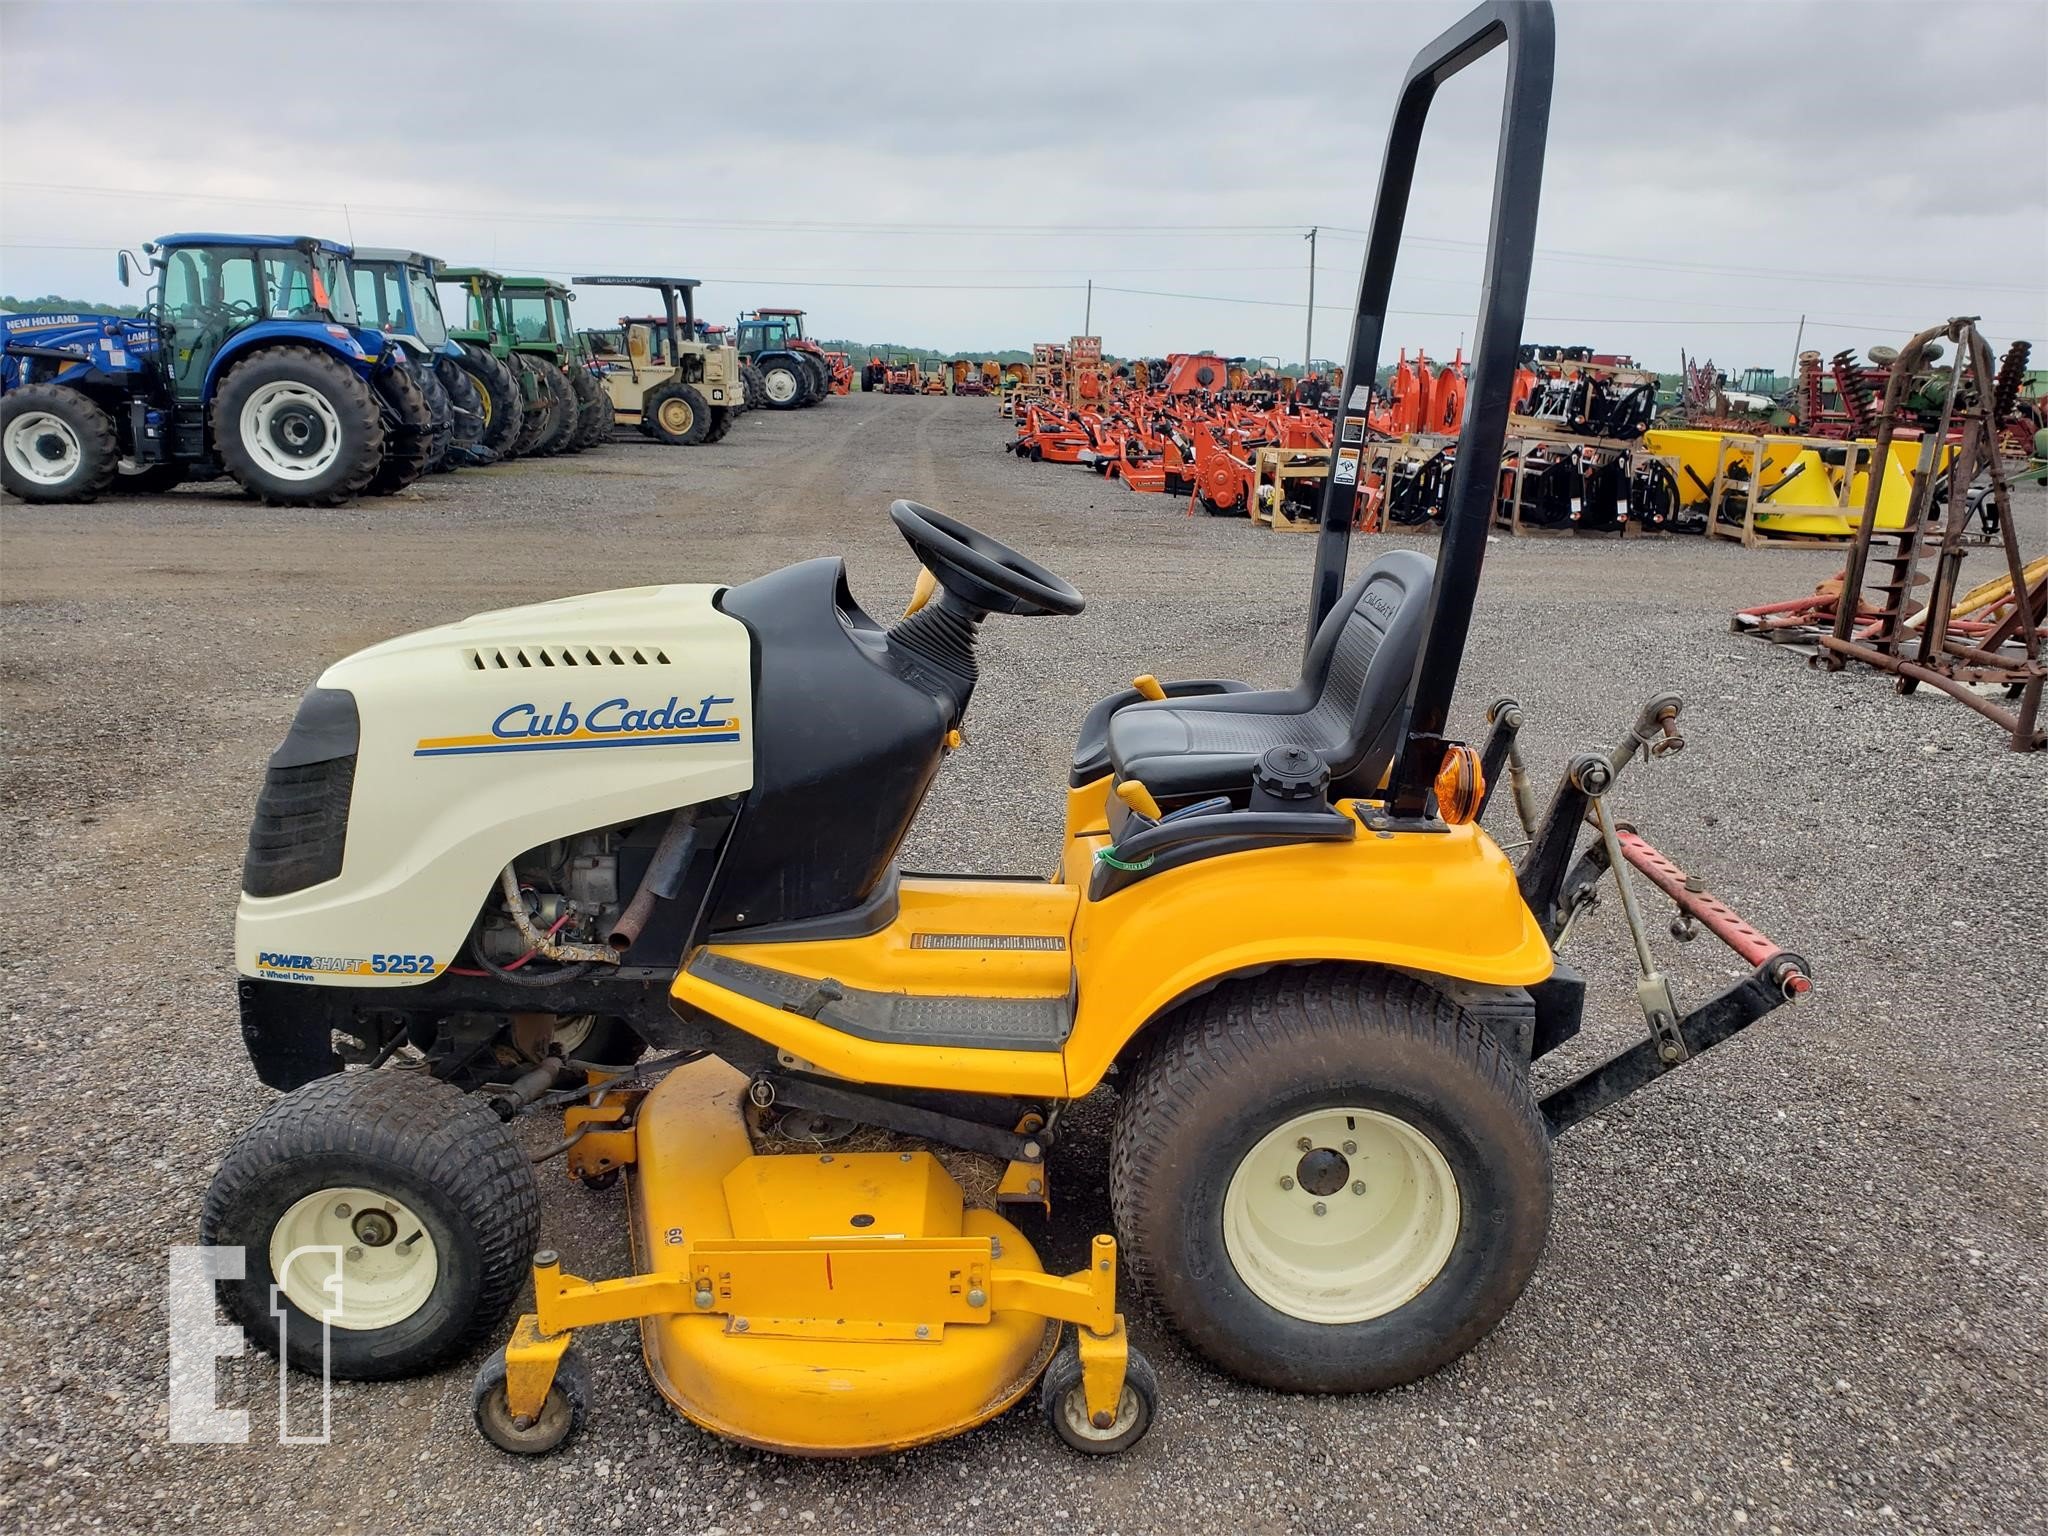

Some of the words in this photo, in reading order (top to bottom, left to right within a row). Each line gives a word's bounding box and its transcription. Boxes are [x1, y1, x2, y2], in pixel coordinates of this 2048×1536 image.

[6, 319, 30, 329] NEW
[32, 315, 79, 326] HOLLAND
[492, 702, 579, 738] Cub
[585, 695, 734, 733] Cadet
[371, 954, 435, 974] 5252
[266, 971, 291, 980] Wheel
[293, 973, 315, 982] Drive
